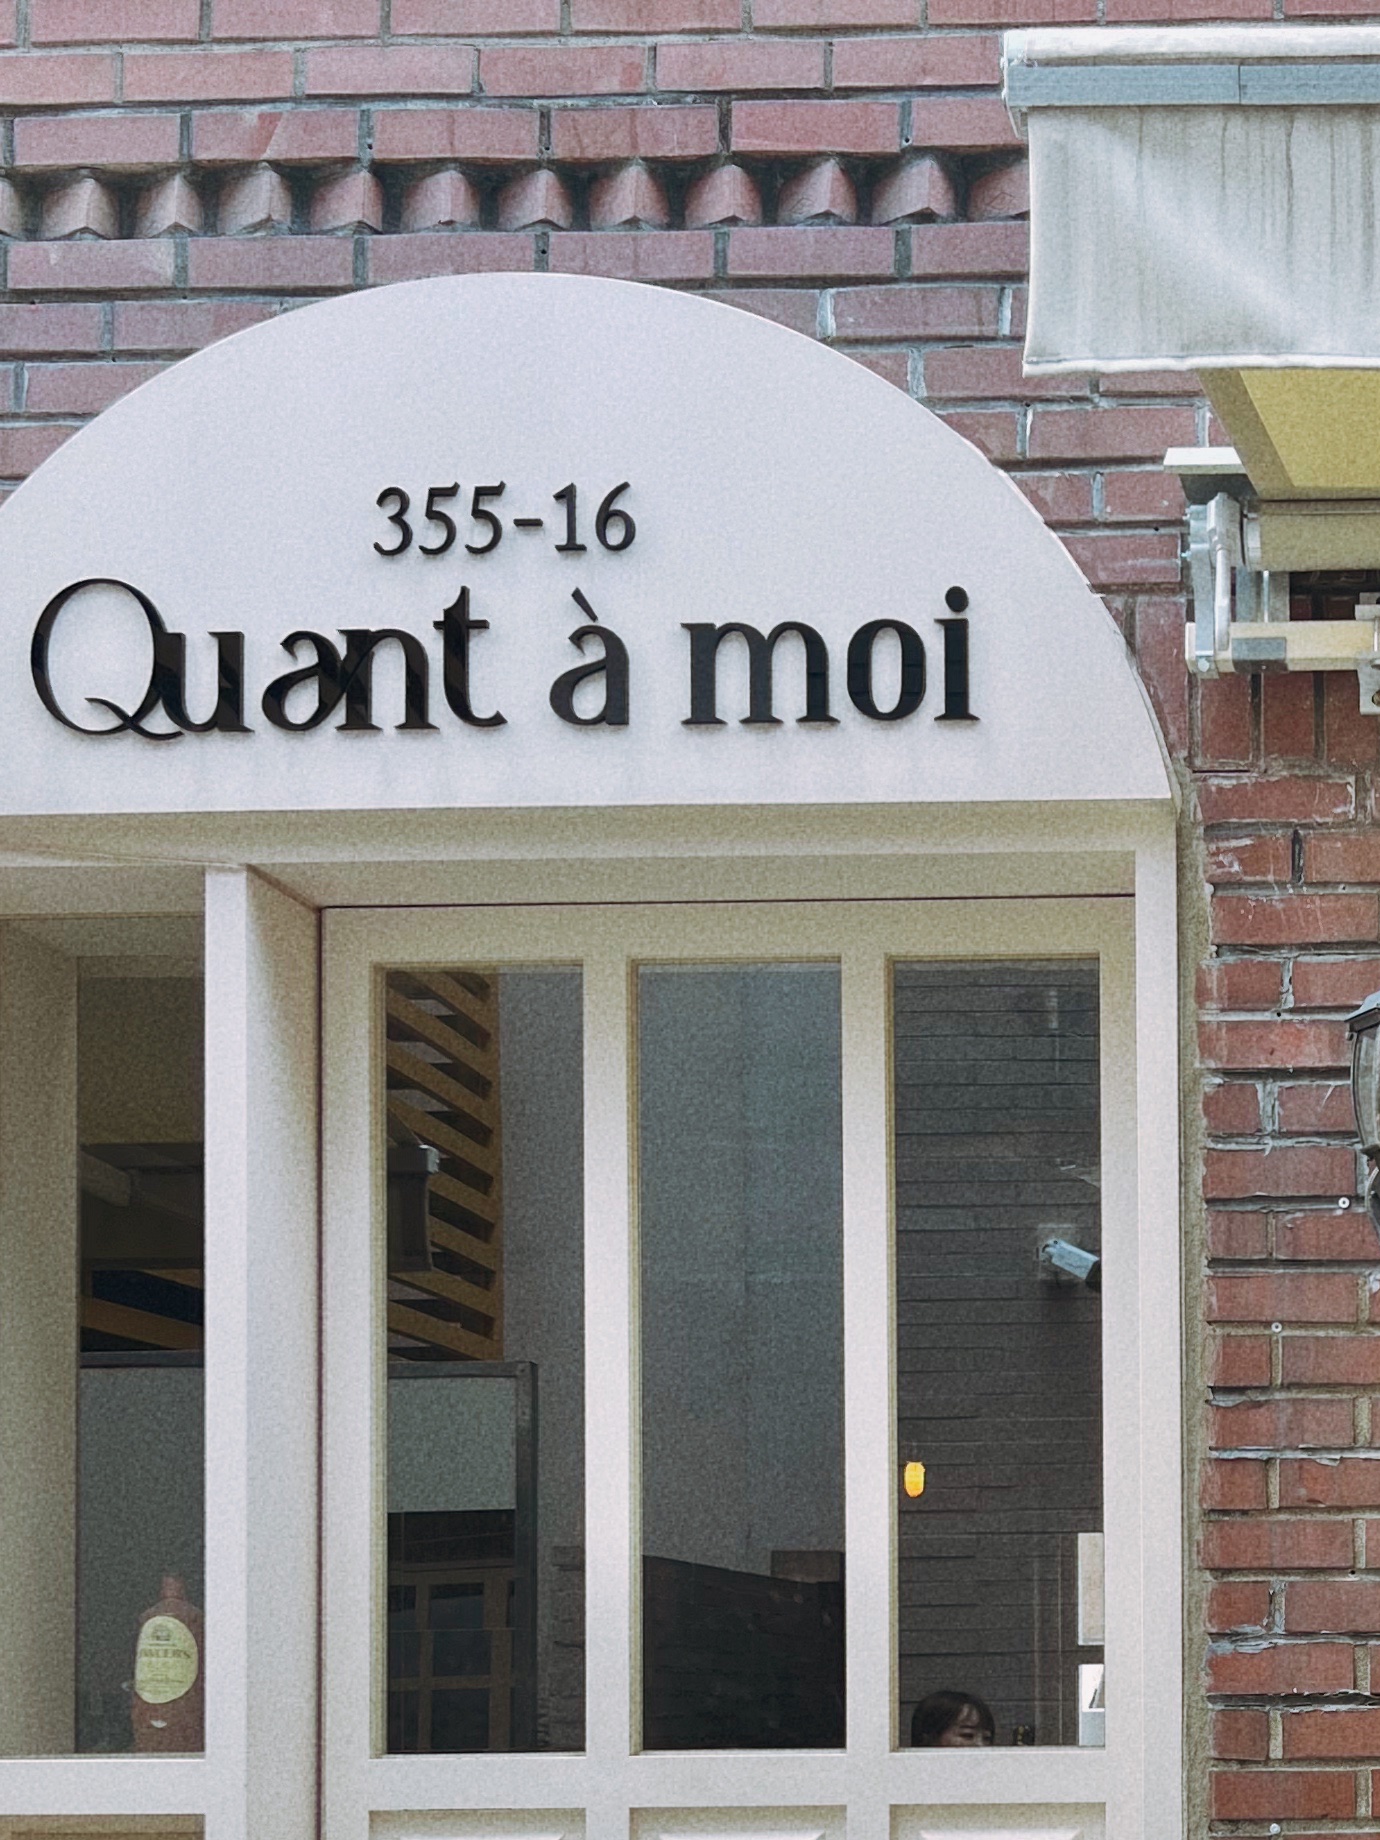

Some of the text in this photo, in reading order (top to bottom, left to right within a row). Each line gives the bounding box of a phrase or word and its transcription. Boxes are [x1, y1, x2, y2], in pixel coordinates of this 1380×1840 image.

[373, 481, 637, 558] 355-16
[31, 577, 981, 742] Quant à moi
